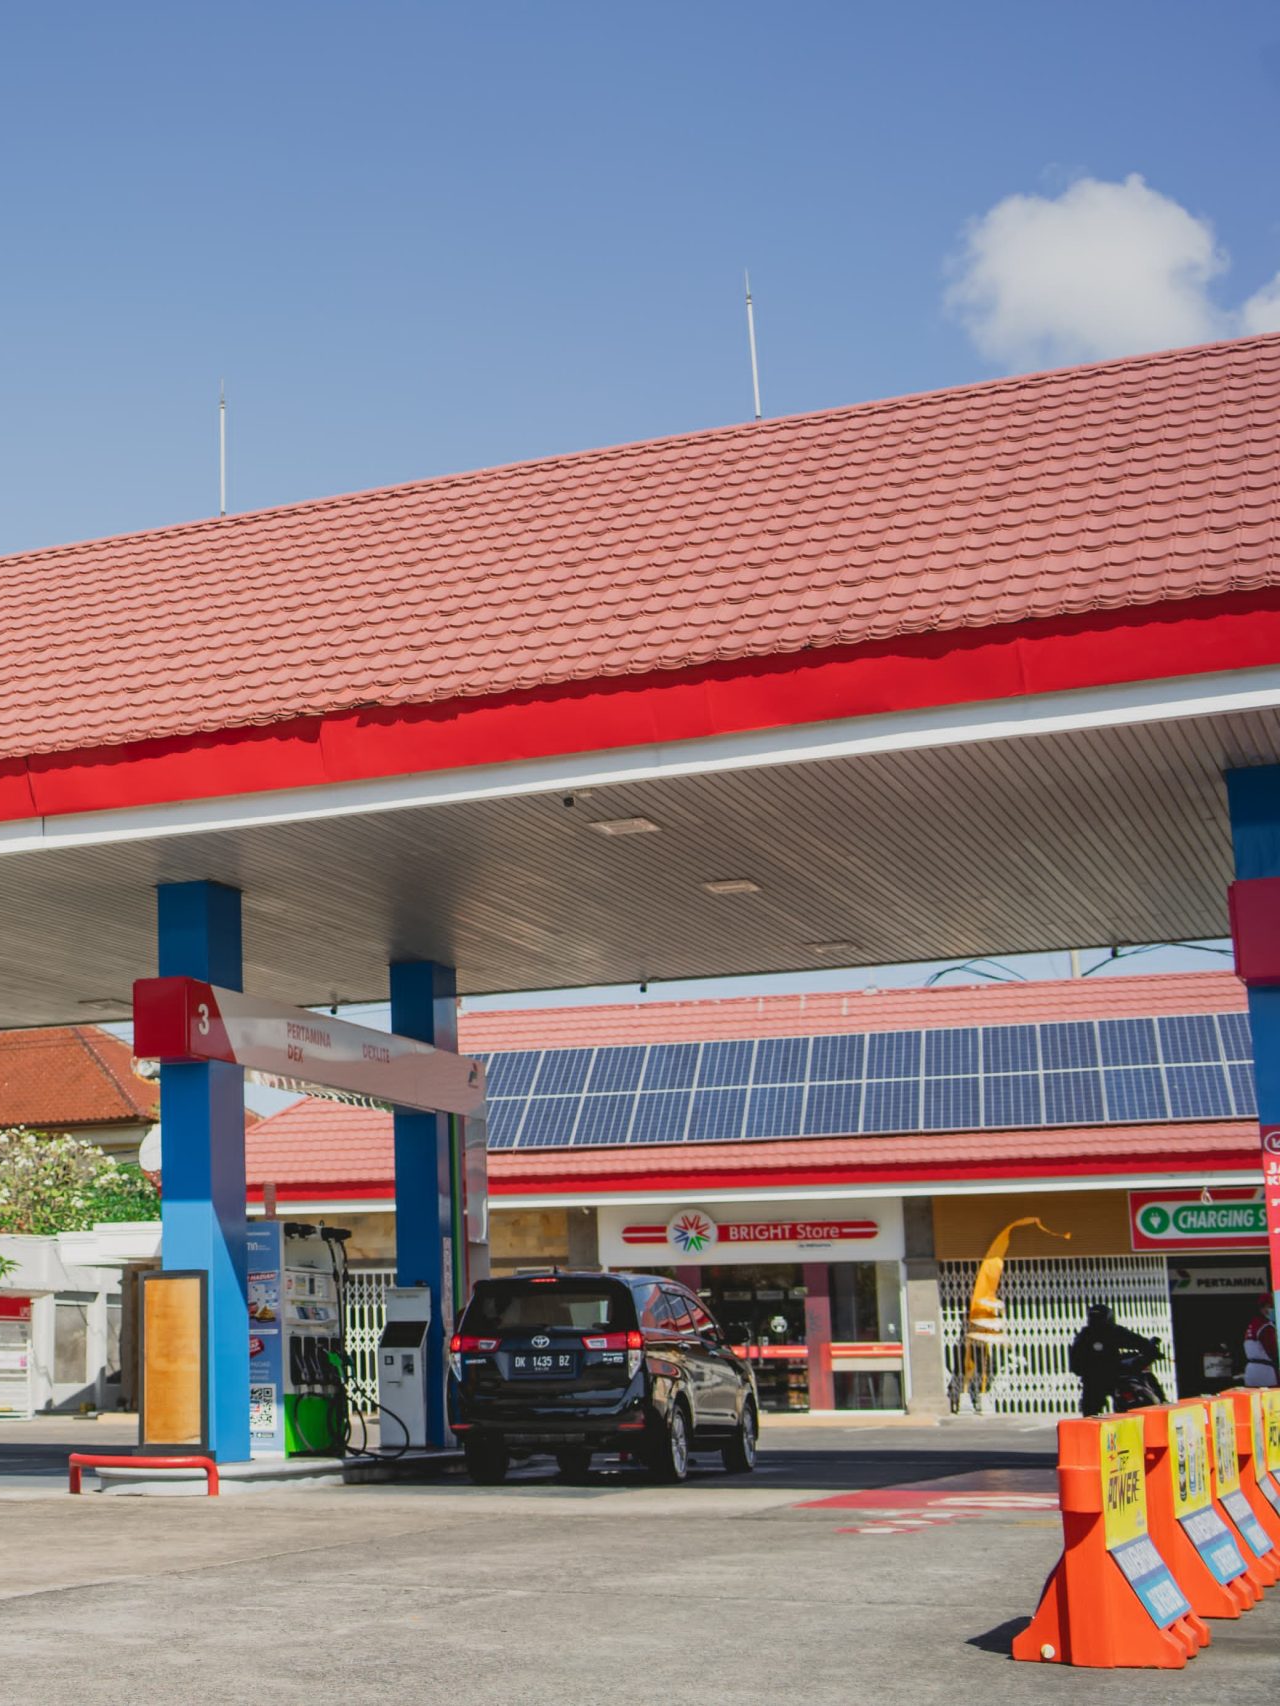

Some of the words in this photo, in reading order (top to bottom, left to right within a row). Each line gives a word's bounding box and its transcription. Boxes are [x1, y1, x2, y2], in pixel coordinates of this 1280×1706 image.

[197, 1003, 210, 1036] 3
[286, 1022, 332, 1049] PERTAMINA
[287, 1044, 304, 1064] DEX
[362, 1043, 391, 1064] DEXLITE
[1178, 1209, 1255, 1229] CHARGING
[728, 1224, 793, 1240] BRIGHT
[796, 1223, 841, 1239] Store
[1196, 1276, 1266, 1288] PERTAMINA
[515, 1357, 526, 1368] DK
[532, 1355, 553, 1368] 1435
[559, 1355, 570, 1367] BZ
[1107, 1470, 1142, 1514] POWER
